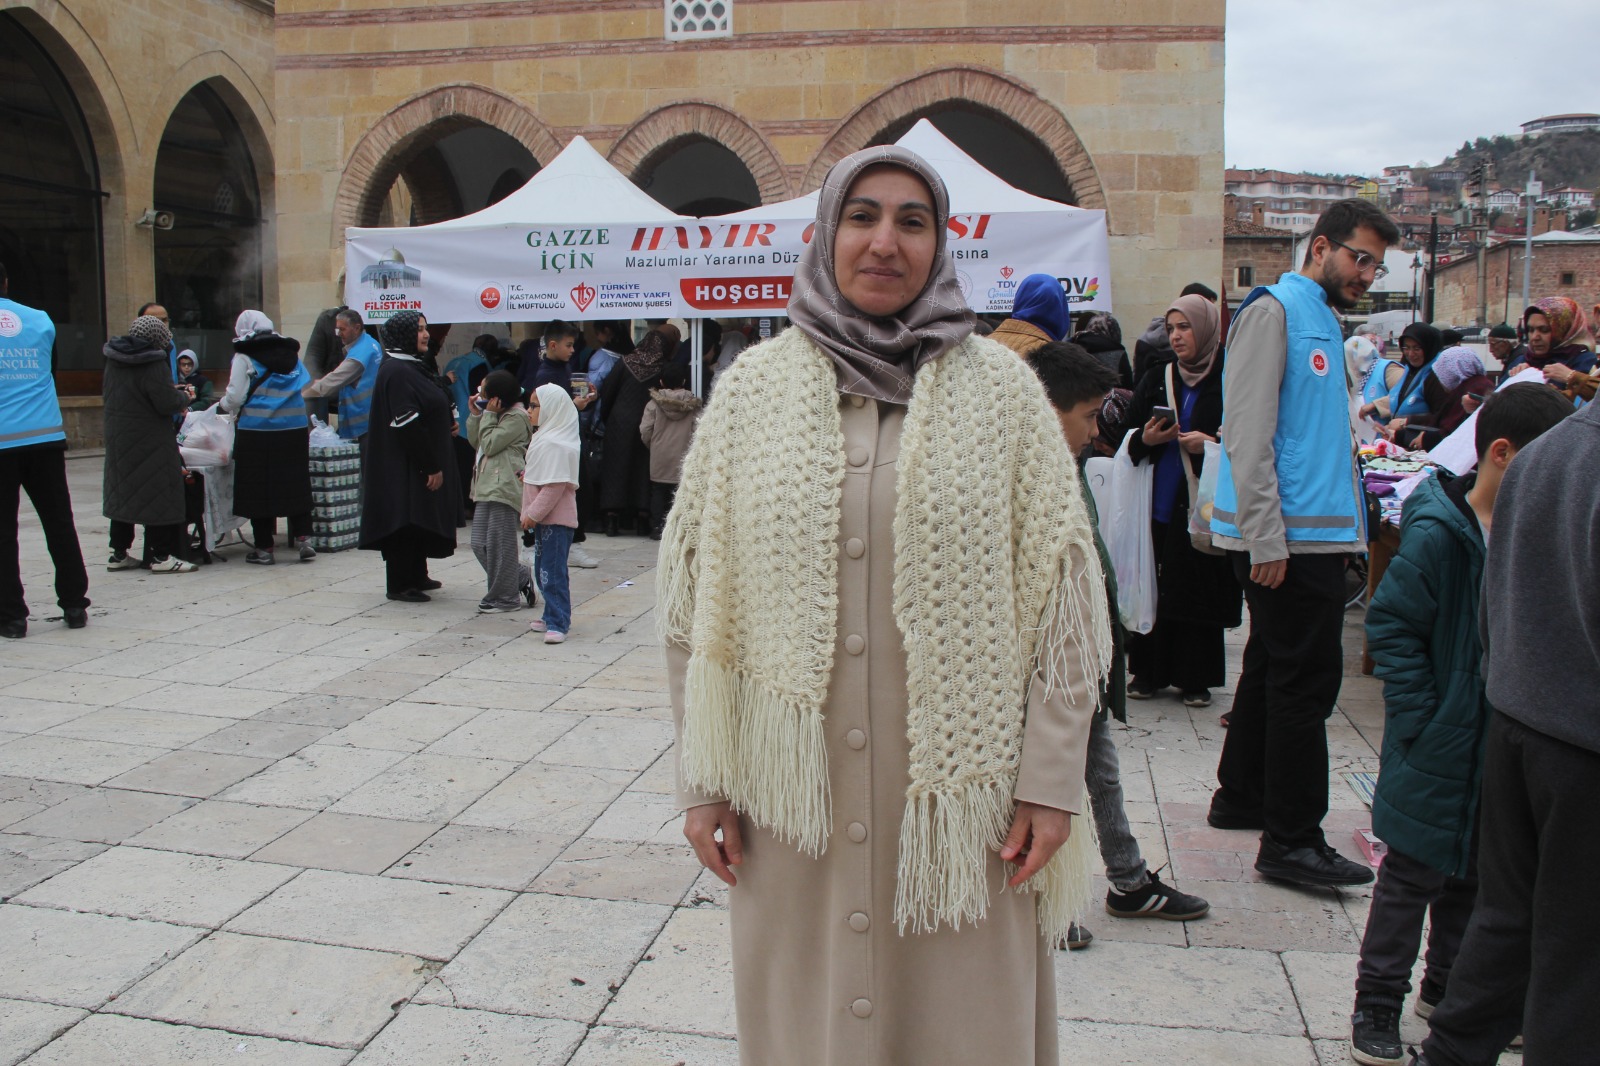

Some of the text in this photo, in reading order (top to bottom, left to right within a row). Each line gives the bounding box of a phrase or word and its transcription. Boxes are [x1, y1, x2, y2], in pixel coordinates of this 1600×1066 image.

[526, 228, 610, 248] GAZZE
[629, 223, 776, 251] HAYIR
[540, 249, 596, 273] İÇİN
[625, 249, 989, 268] Mazlumlar Yararına Düz ısına
[600, 282, 640, 291] TÜRKİYE
[1057, 277, 1088, 294] DV
[379, 293, 407, 301] ÖZGÜR
[600, 291, 671, 299] DİYANET VAKFI
[695, 283, 790, 304] HOŞGEL
[988, 287, 1015, 299] Gönüll
[509, 301, 566, 310] İL MÜFTÜLÜĞÜ
[645, 299, 672, 310] ŞUBESİ
[369, 311, 398, 319] YANIN
